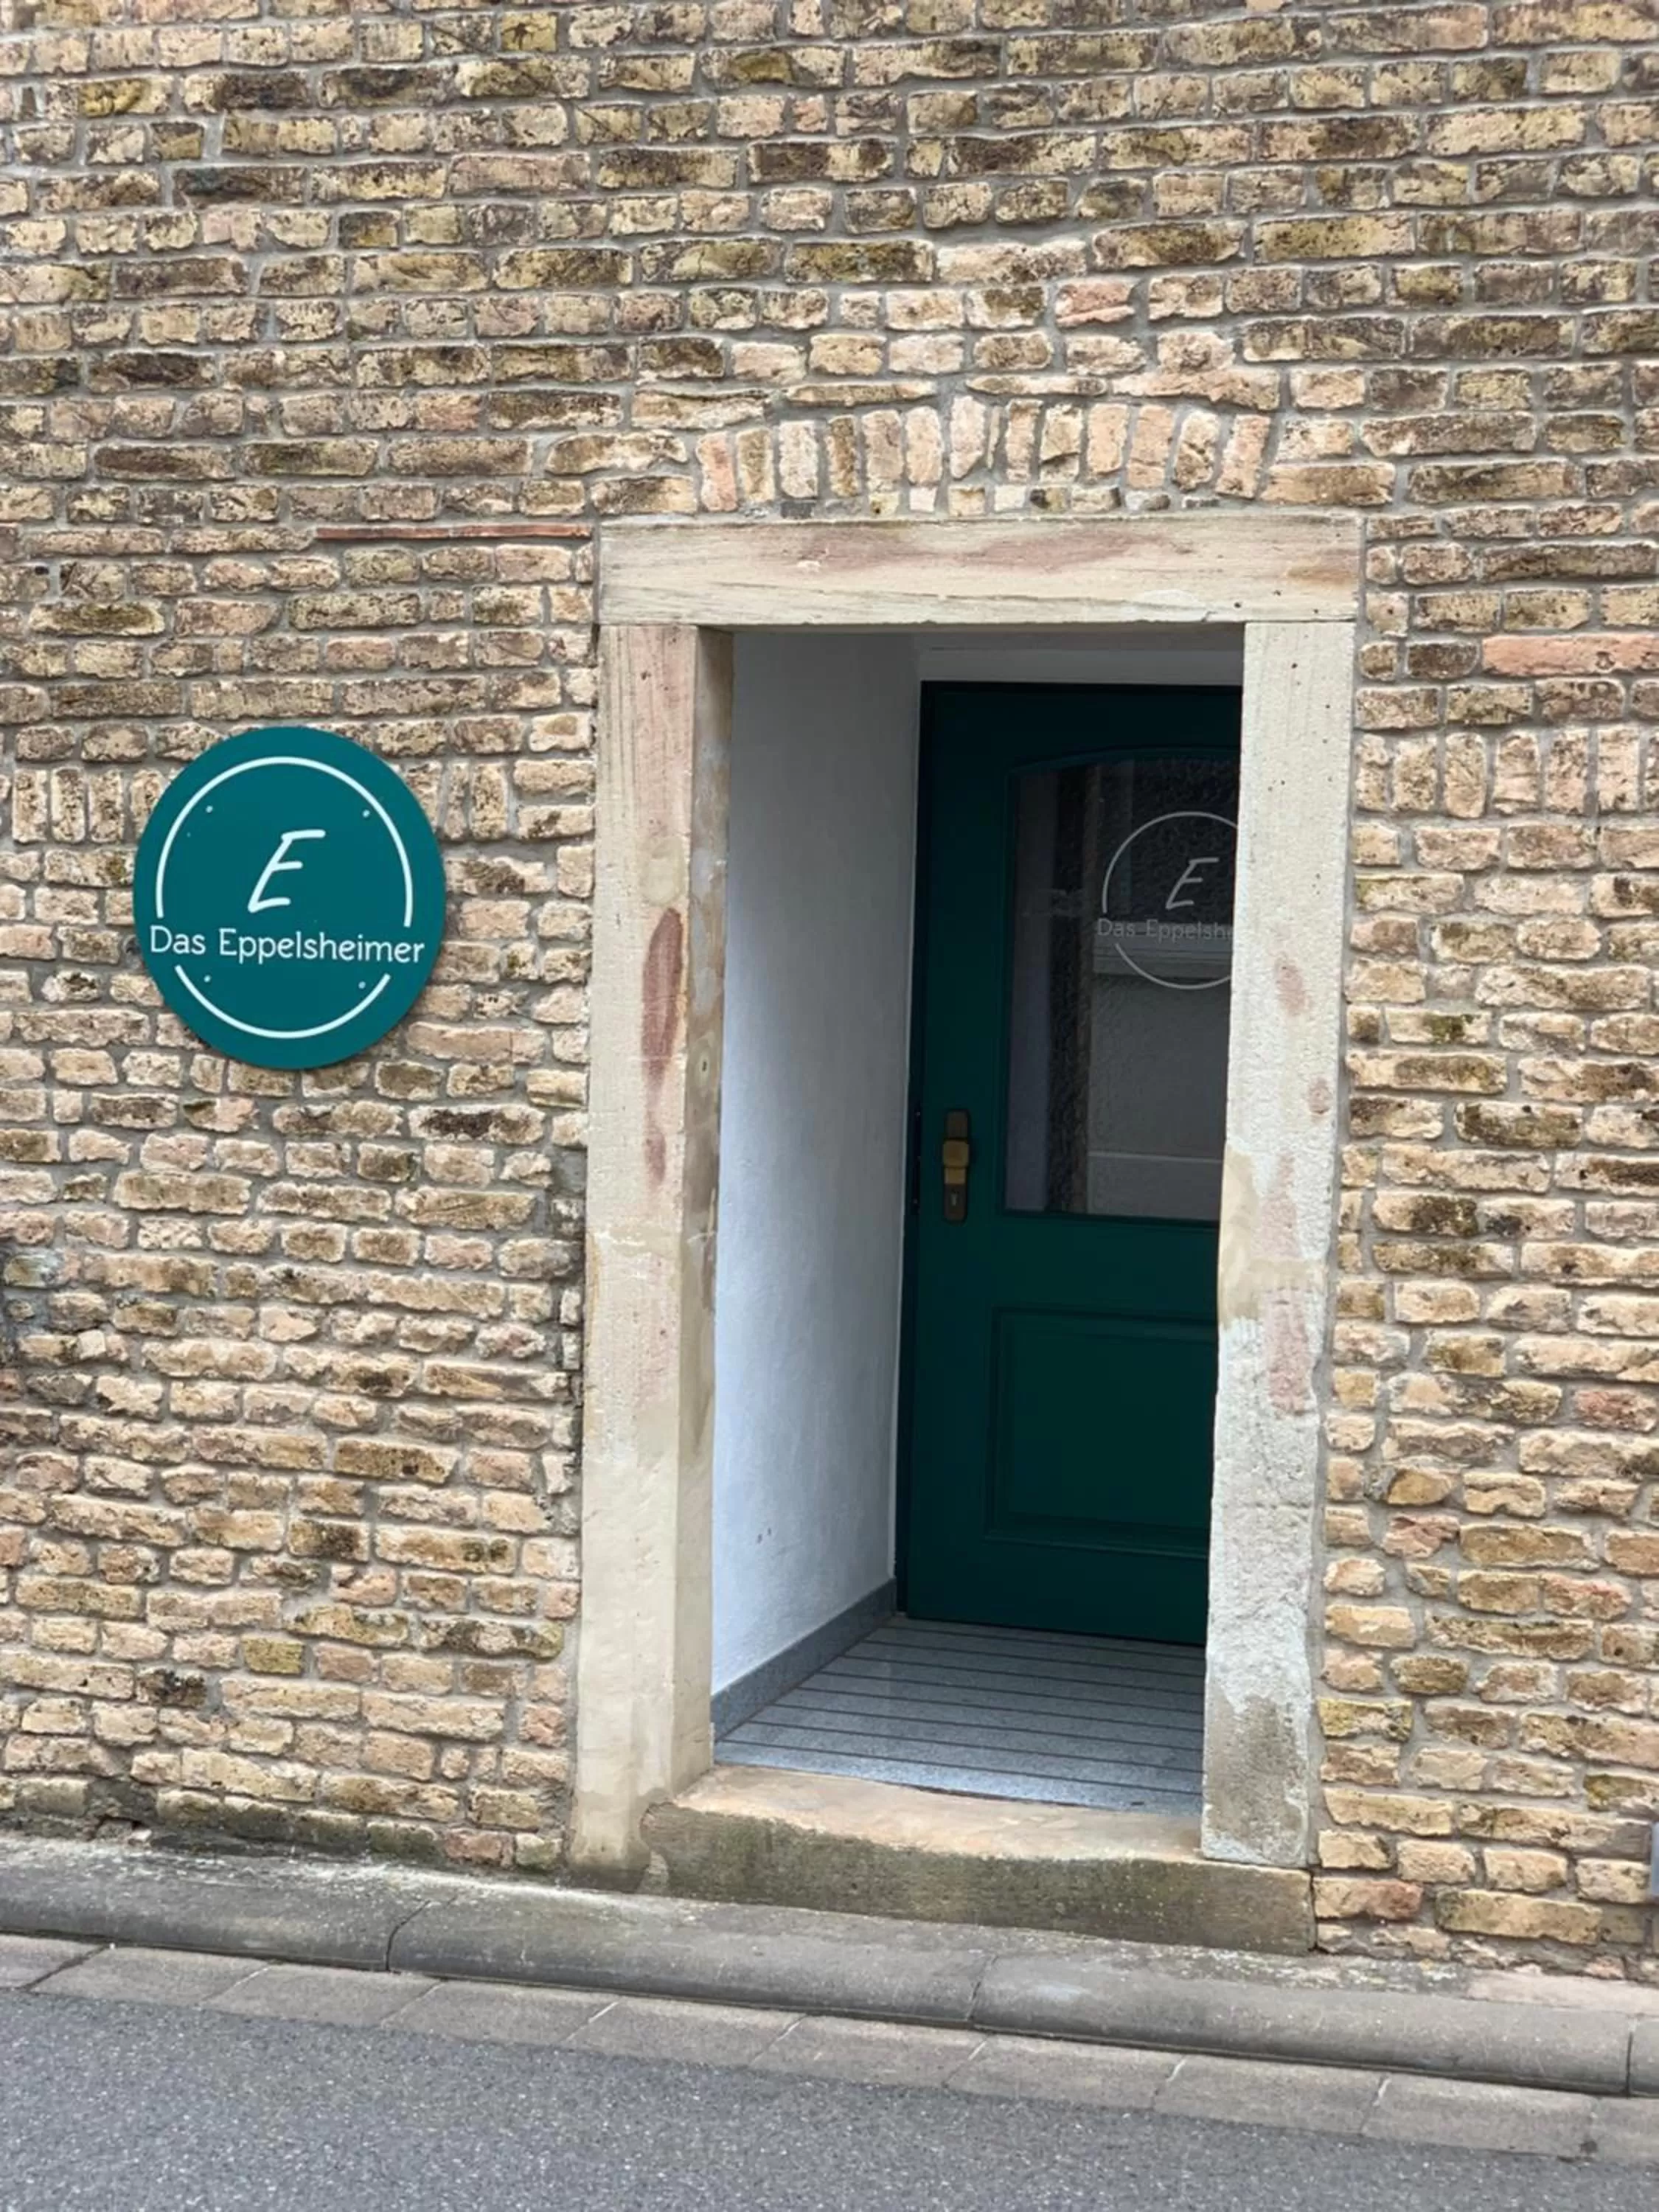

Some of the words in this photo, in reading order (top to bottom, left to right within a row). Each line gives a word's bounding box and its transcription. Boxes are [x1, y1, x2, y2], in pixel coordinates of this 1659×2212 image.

[247, 829, 326, 913] E
[1165, 857, 1219, 910] E
[150, 925, 206, 955] Das
[218, 928, 425, 964] Eppelsheimer
[1096, 917, 1136, 937] Das
